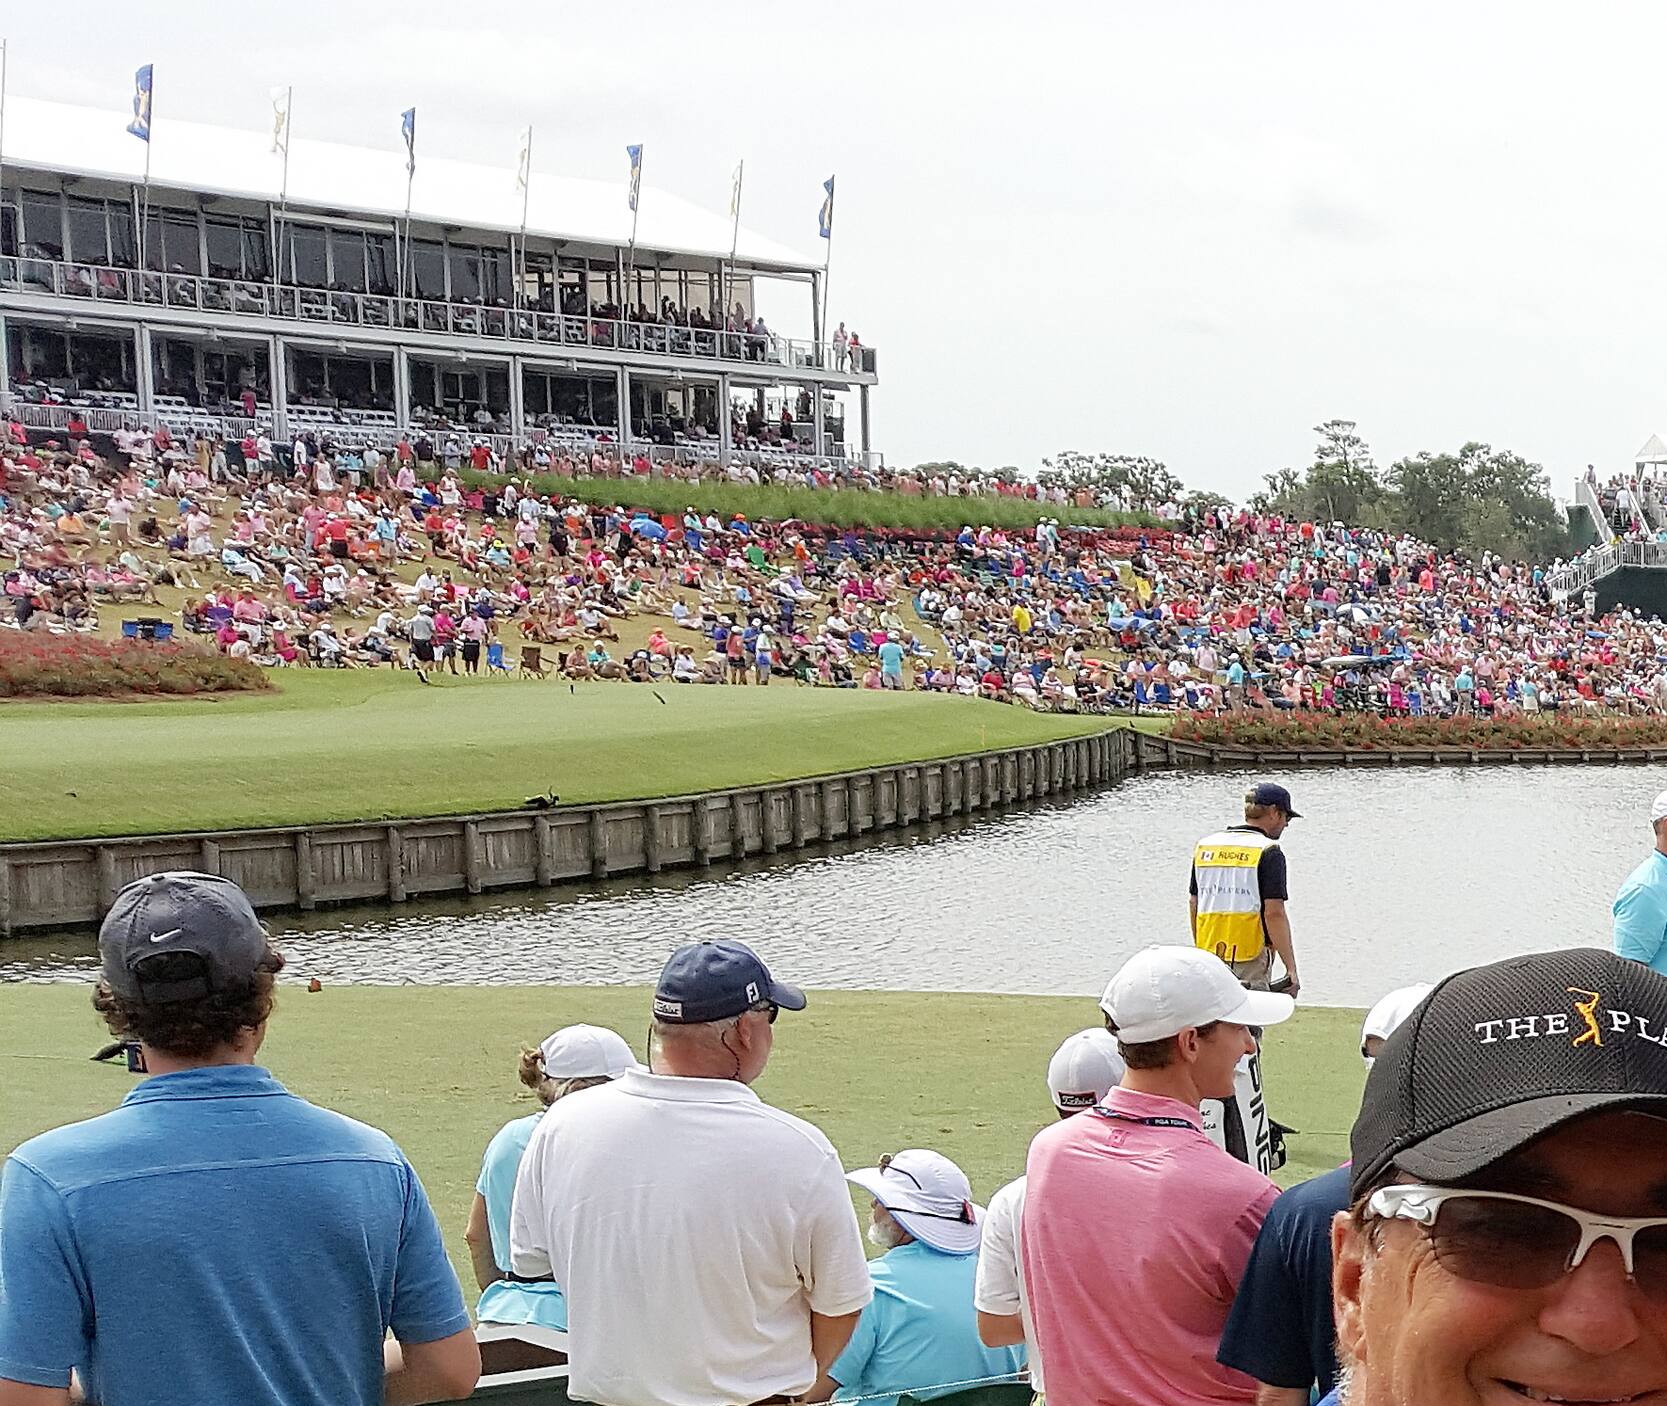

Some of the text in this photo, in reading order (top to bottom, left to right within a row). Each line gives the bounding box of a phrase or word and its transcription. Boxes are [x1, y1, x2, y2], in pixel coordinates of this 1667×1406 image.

[1218, 851, 1251, 862] HUGHES
[1474, 1012, 1569, 1044] THE
[1248, 1054, 1273, 1176] PING
